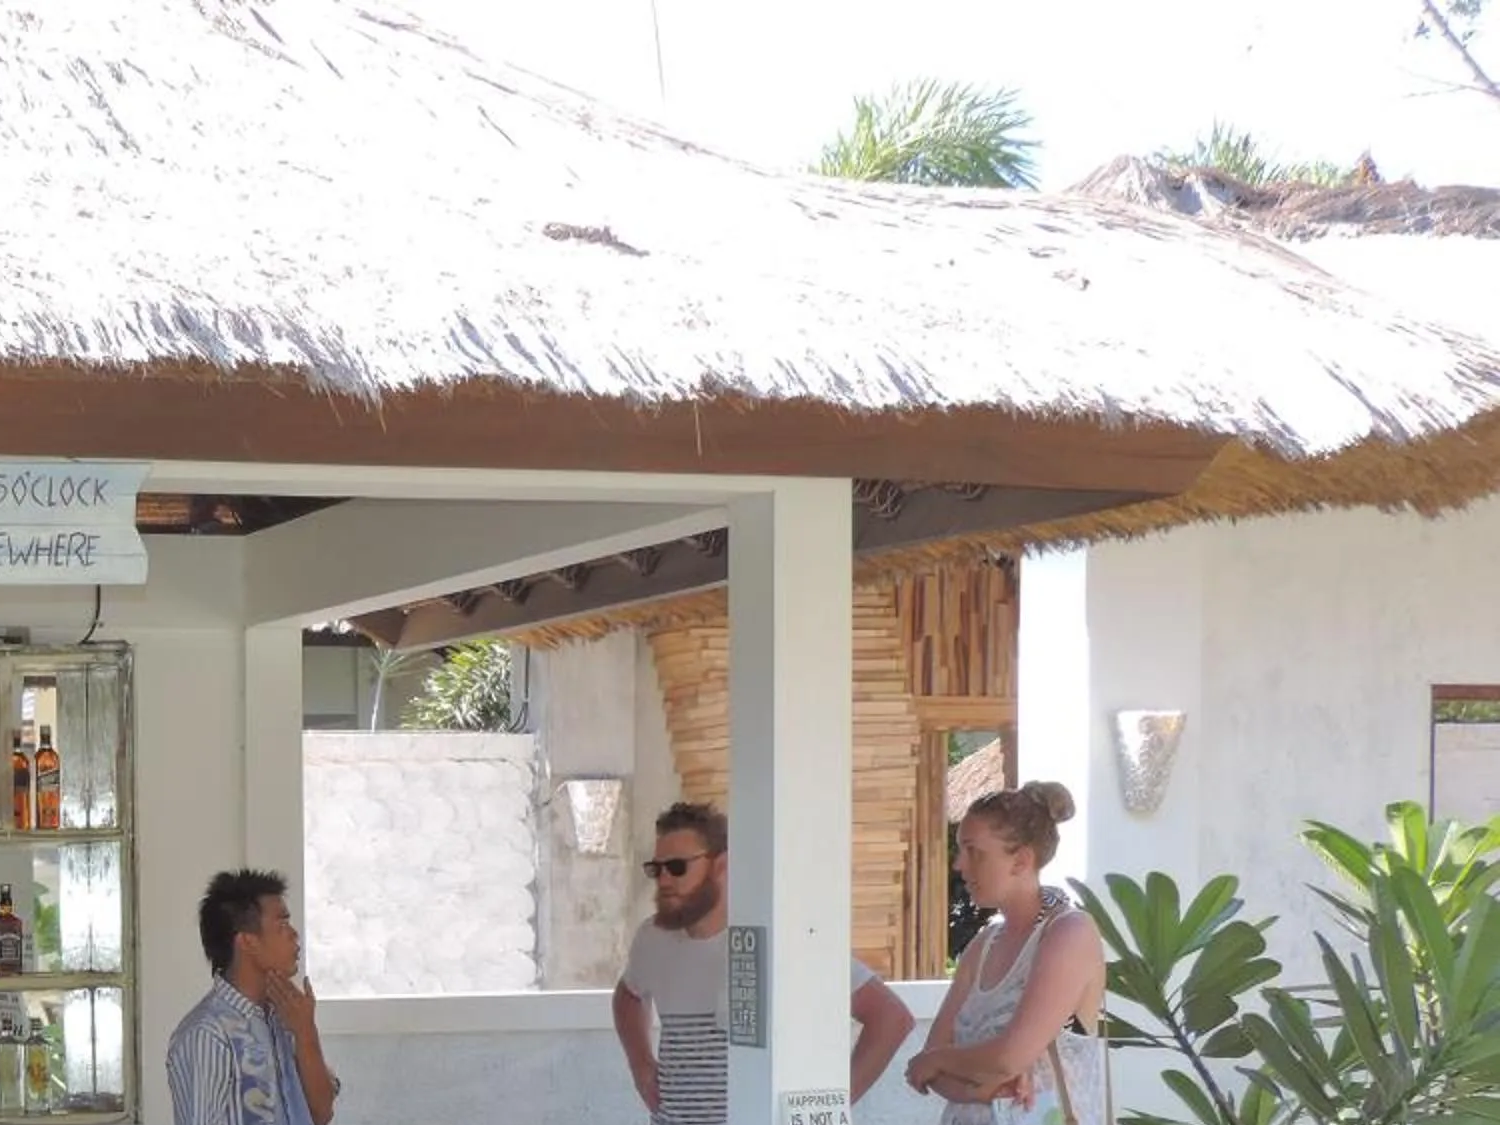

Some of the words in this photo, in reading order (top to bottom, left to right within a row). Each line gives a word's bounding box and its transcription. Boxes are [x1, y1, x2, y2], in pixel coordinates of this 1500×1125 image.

[731, 929, 756, 952] GO
[787, 1094, 846, 1108] HAPPINESS
[839, 1111, 849, 1125] A
